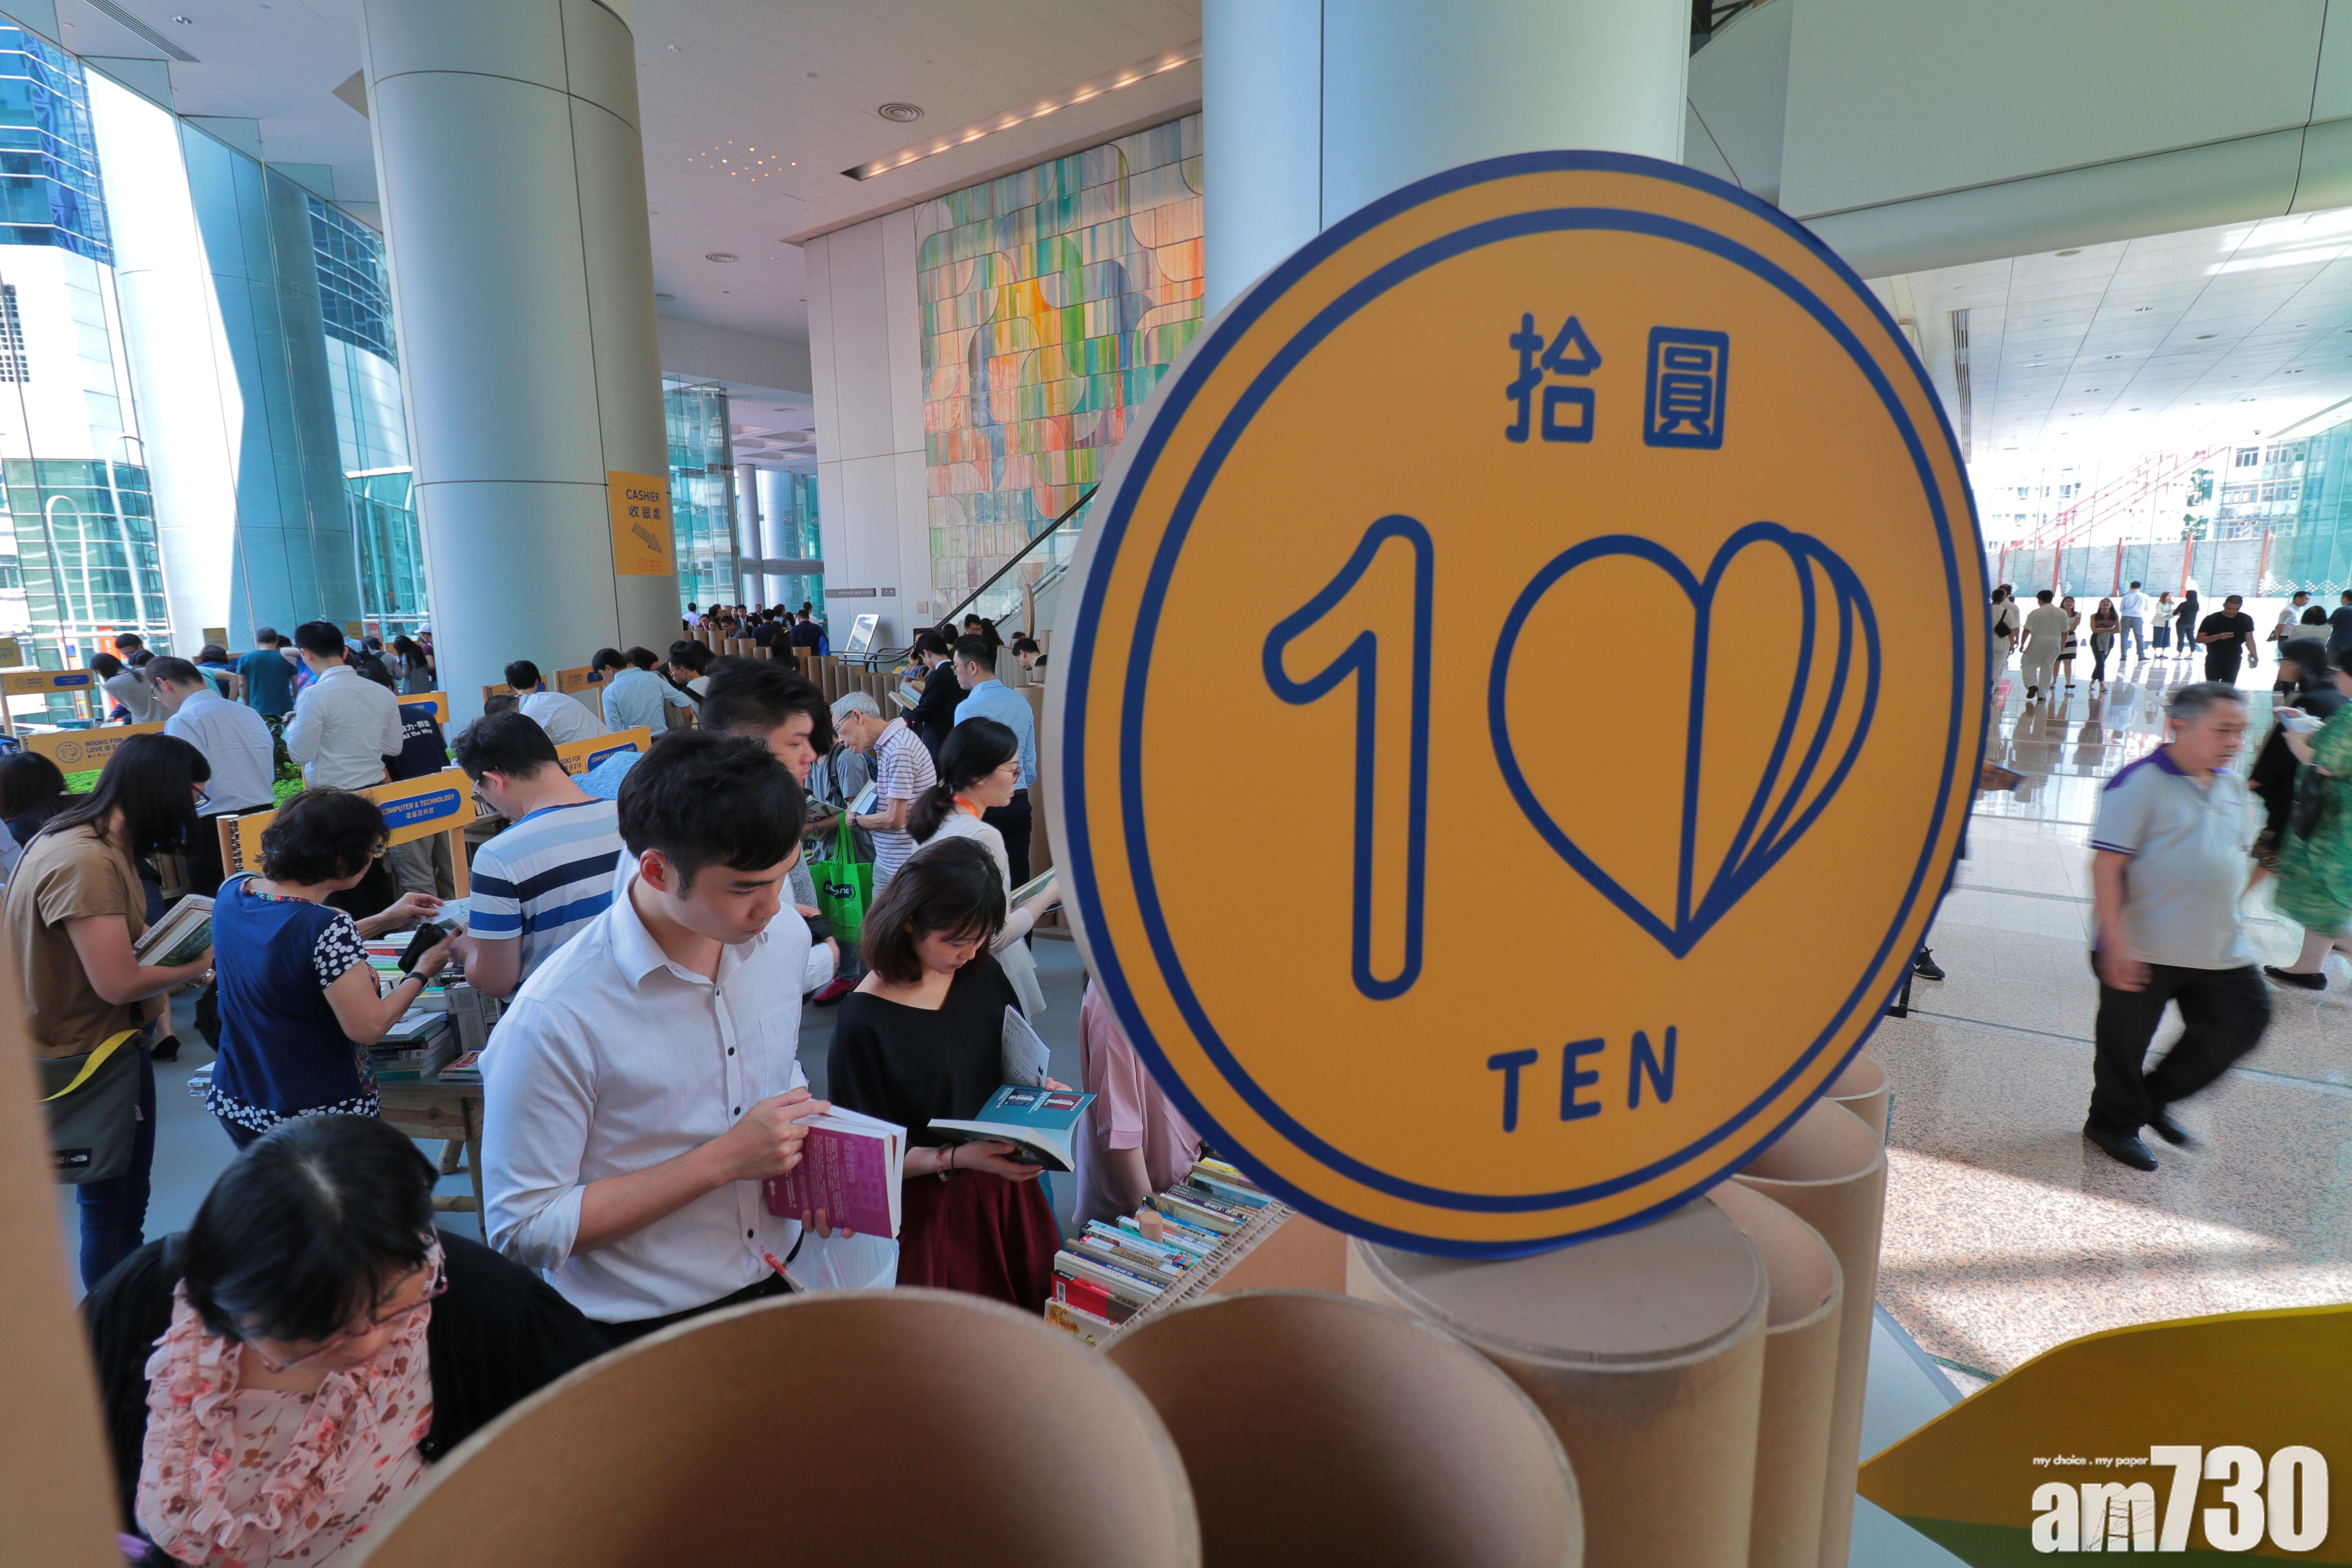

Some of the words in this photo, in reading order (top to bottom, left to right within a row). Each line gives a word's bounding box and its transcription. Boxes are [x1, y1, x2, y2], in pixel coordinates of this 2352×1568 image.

[1505, 312, 1730, 450] 拾圓
[626, 489, 660, 502] CASHIER
[628, 505, 661, 520] 收銀處
[381, 802, 414, 816] COMPUTER
[419, 794, 455, 807] TECHNOLOGY
[1486, 1025, 1677, 1133] TEN
[1120, 1250, 1155, 1266] MATERIALS
